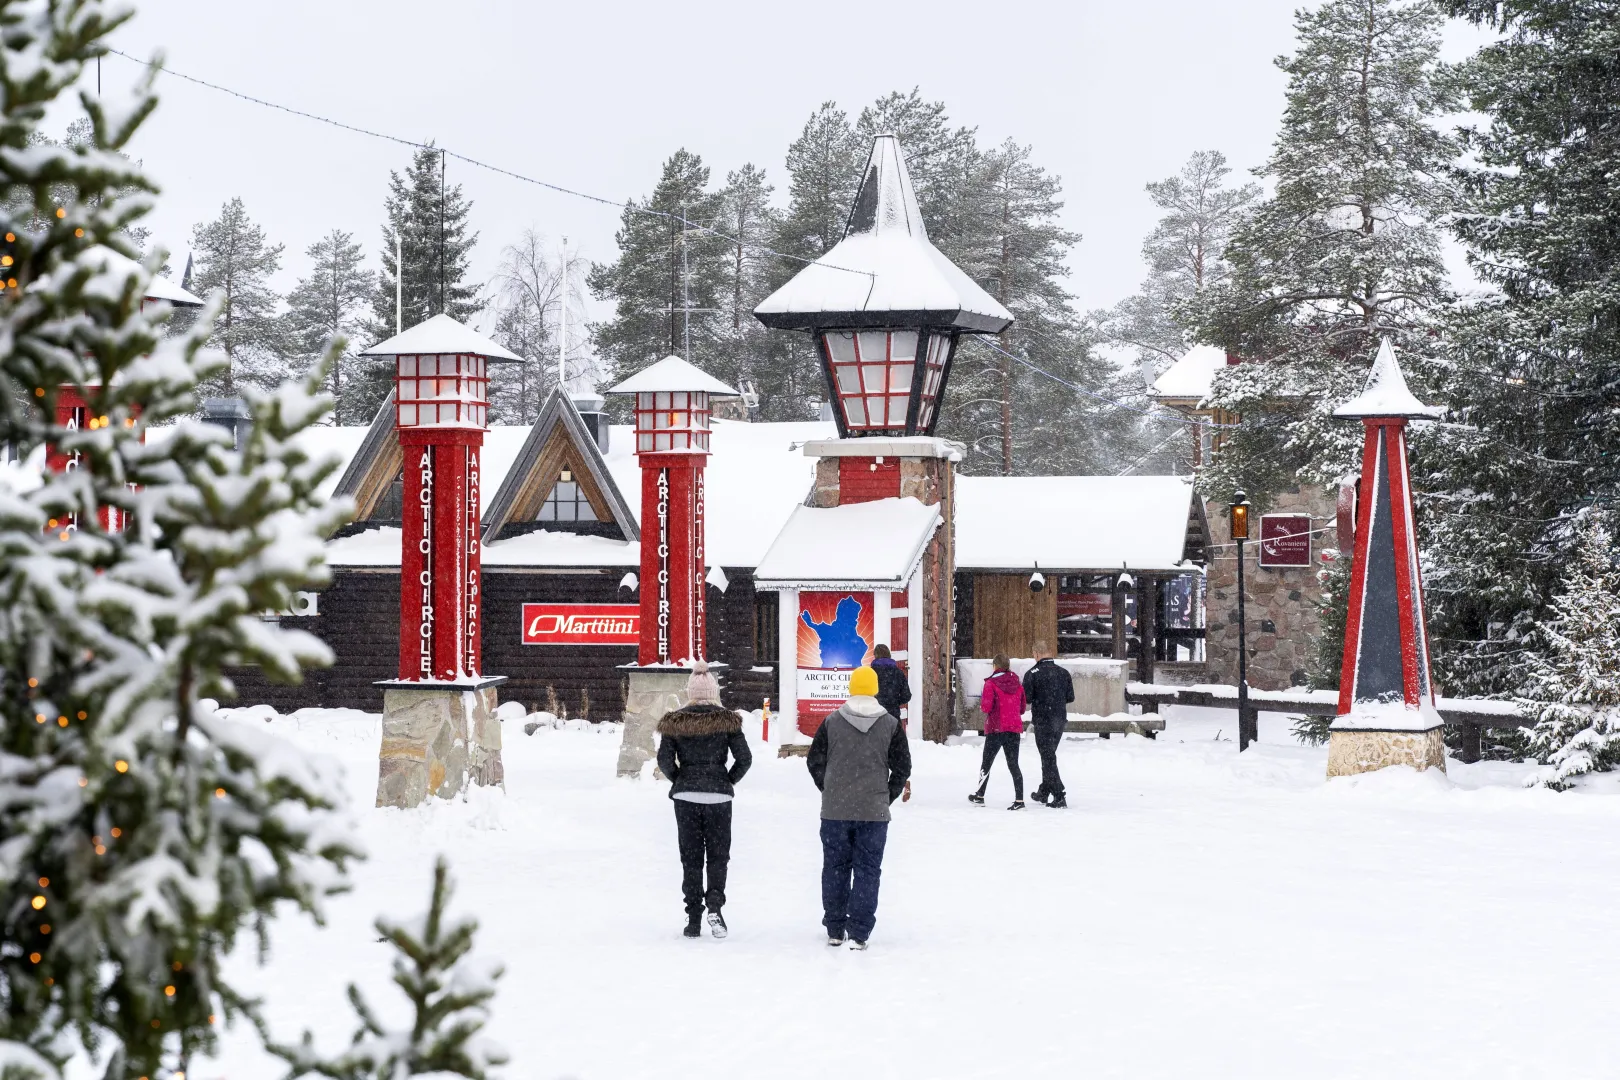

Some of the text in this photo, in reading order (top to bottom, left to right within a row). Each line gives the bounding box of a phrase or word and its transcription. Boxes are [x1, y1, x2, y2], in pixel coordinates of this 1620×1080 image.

[468, 453, 478, 671] ARCTIC CIRCLE
[656, 473, 670, 655] ARCTIC CIRCLE
[696, 473, 705, 656] ARCTIC CIRCLE
[1273, 537, 1308, 547] Rovaniemi
[420, 570, 434, 672] CIRCLE
[529, 614, 638, 636] Marttiini
[804, 673, 837, 681] ARCTIC
